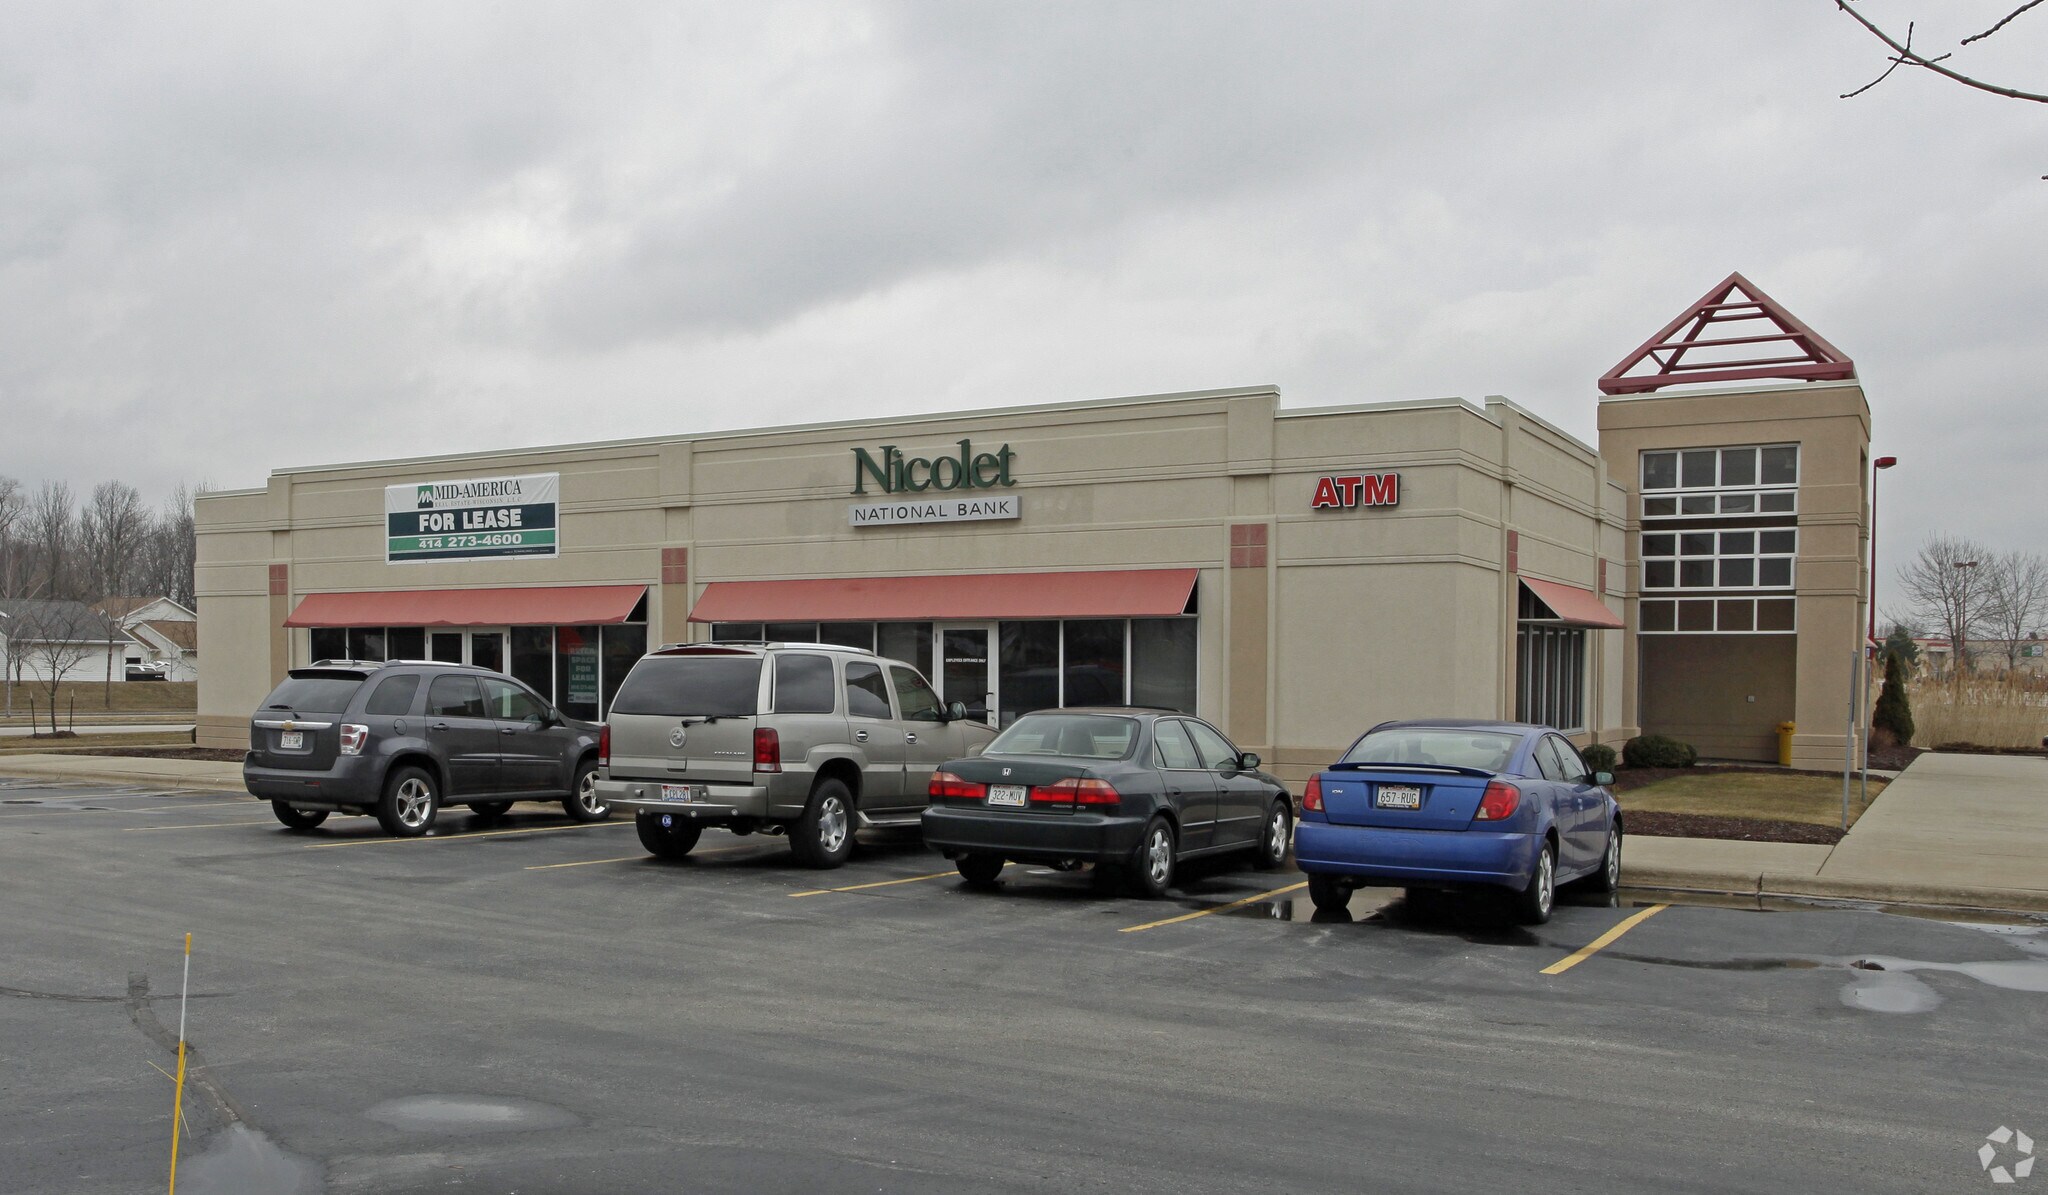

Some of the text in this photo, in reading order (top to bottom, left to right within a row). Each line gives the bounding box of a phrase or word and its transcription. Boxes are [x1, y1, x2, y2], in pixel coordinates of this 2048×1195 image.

[850, 438, 1017, 494] Nicolet
[435, 480, 522, 500] MID-AMERICA
[1310, 472, 1399, 509] ATM
[419, 508, 522, 532] FOR LEASE
[855, 501, 1010, 521] NATIONAL BANK
[419, 533, 522, 549] 414 273-4600
[992, 789, 1024, 802] 322-MUV
[1380, 791, 1418, 805] 657-RUG
